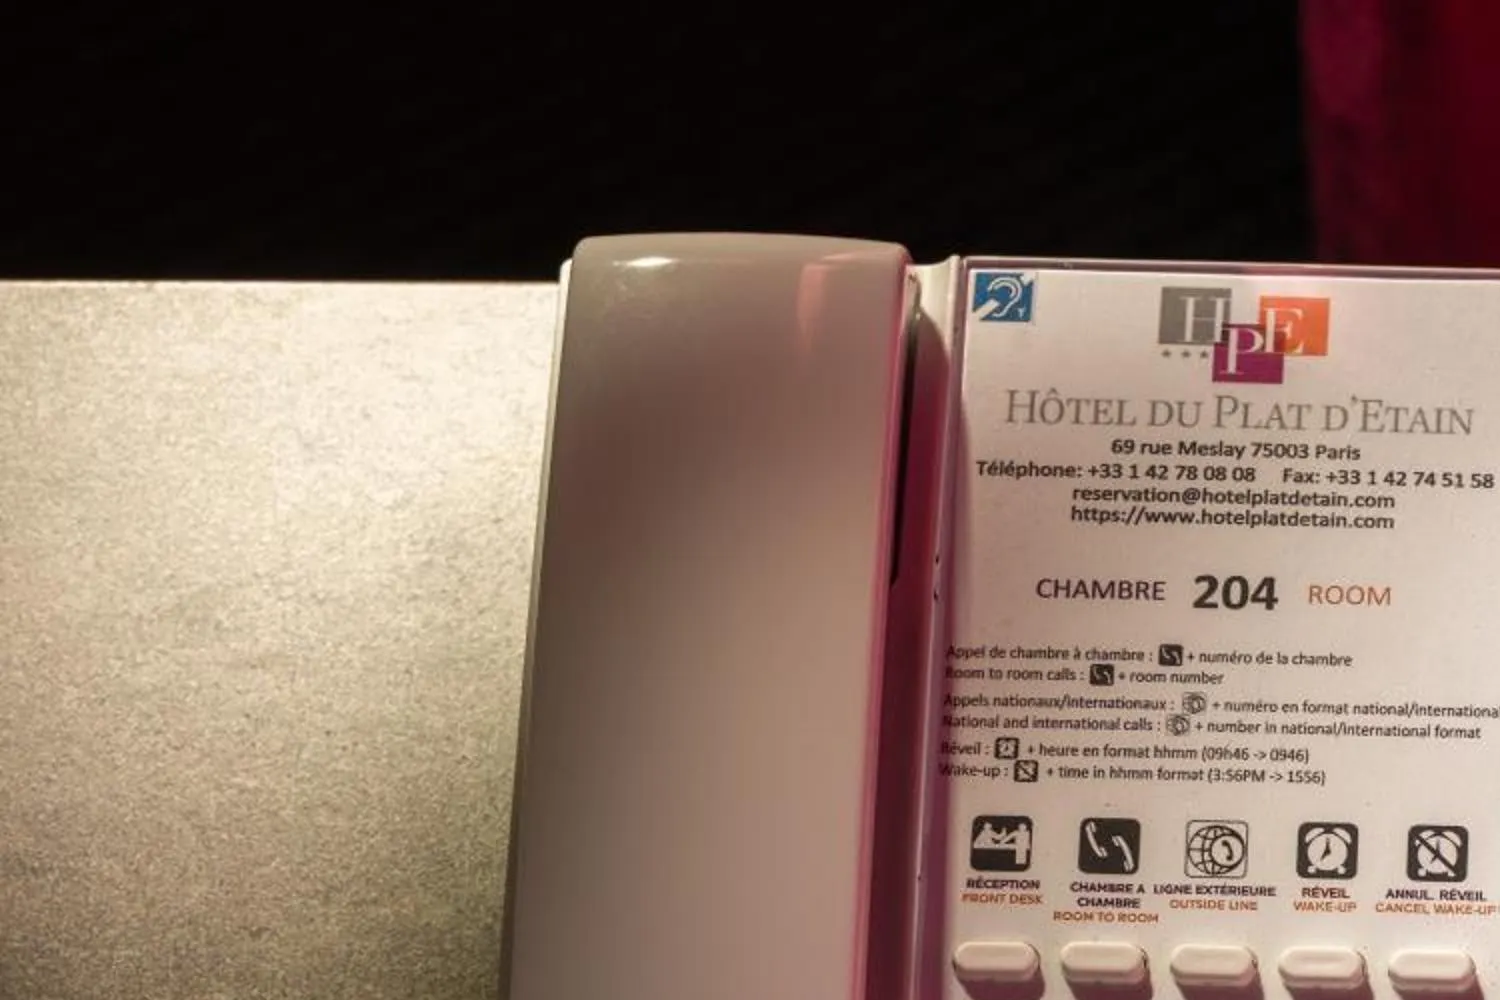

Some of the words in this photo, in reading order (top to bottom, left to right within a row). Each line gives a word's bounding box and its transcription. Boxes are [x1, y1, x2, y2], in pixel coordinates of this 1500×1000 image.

[1111, 439, 1135, 455] 69
[1140, 442, 1172, 456] rue
[1178, 441, 1246, 460] Meslay
[1251, 443, 1309, 459] 75003
[1315, 445, 1361, 461] Paris
[976, 459, 1082, 480] Téléphone:
[1087, 464, 1122, 479] +33
[1129, 465, 1140, 479] 1
[1145, 465, 1168, 480] 42
[1176, 465, 1198, 480] 78
[1203, 466, 1227, 481] 08
[1232, 467, 1256, 482] 08
[1282, 467, 1320, 485] Fax:
[1326, 469, 1361, 485] +33
[1368, 471, 1377, 486] 1
[1384, 471, 1407, 487] 42
[1413, 471, 1436, 487] 74
[1441, 472, 1464, 488] 51
[1470, 473, 1495, 489] 58
[1072, 487, 1396, 508] reservation@hotelplatdetain.com
[1071, 505, 1395, 529] https://www.hotelplatdetain.com
[1035, 578, 1166, 601] CHAMBRE
[1192, 574, 1278, 610] 204
[1308, 585, 1391, 606] ROOM
[946, 645, 988, 662] Appel
[989, 646, 1006, 659] de
[1010, 647, 1069, 661] chambre
[1073, 646, 1081, 660] à
[1085, 648, 1145, 662] chambre
[1200, 651, 1253, 665] numéro
[1256, 652, 1273, 664] de
[1277, 652, 1288, 665] la
[1292, 652, 1353, 667] chambre
[946, 666, 984, 680] Room
[989, 667, 1003, 680] to
[1007, 669, 1043, 681] room
[1047, 668, 1076, 681] calls
[1130, 671, 1167, 683] room
[1170, 671, 1224, 685] number
[943, 694, 989, 709] Appels
[993, 695, 1167, 711] nationaux/internationaux
[1224, 700, 1278, 713] numéro
[1282, 703, 1299, 714] en
[1303, 700, 1348, 715] format
[942, 715, 998, 729] National
[1003, 716, 1028, 730] and
[1033, 717, 1121, 731] international
[1124, 718, 1153, 732] calls
[1207, 720, 1261, 734] number
[1265, 721, 1277, 734] in
[1281, 722, 1431, 738] national/international
[1435, 724, 1481, 739] format
[940, 741, 982, 756] Réveil
[1040, 743, 1078, 757] heure
[1082, 746, 1099, 757] en
[1102, 744, 1149, 759] format
[1153, 745, 1197, 759] hhmm
[1201, 747, 1249, 762] (09h46
[1270, 748, 1309, 764] 0946)
[938, 762, 1000, 779] Wake-up
[1058, 765, 1088, 779] time
[1093, 765, 1105, 779] in
[1109, 765, 1152, 779] hhmm
[1157, 766, 1204, 782] format
[1207, 769, 1265, 784] (3:56PM
[1287, 770, 1326, 786] 1556)
[966, 877, 1040, 890] RÉCEPTION
[1070, 881, 1132, 894] CHAMBRE
[1153, 884, 1192, 895] LIGNE
[1195, 882, 1276, 897] EXTÉRIEURE
[1301, 885, 1350, 899] RÉVEIL
[962, 893, 1006, 904] FRONT
[1008, 894, 1043, 905] DESK
[1077, 896, 1141, 908] CHAMBRE
[1439, 887, 1487, 901] RÉVEIL
[1169, 898, 1225, 910] OUTSIDE
[1229, 900, 1258, 911] LINE
[1294, 901, 1357, 913] WAKE-UP
[1376, 903, 1429, 915] CANCEL
[1053, 911, 1094, 921] ROOM
[1096, 911, 1115, 922] TO
[1118, 912, 1159, 923] ROOM
